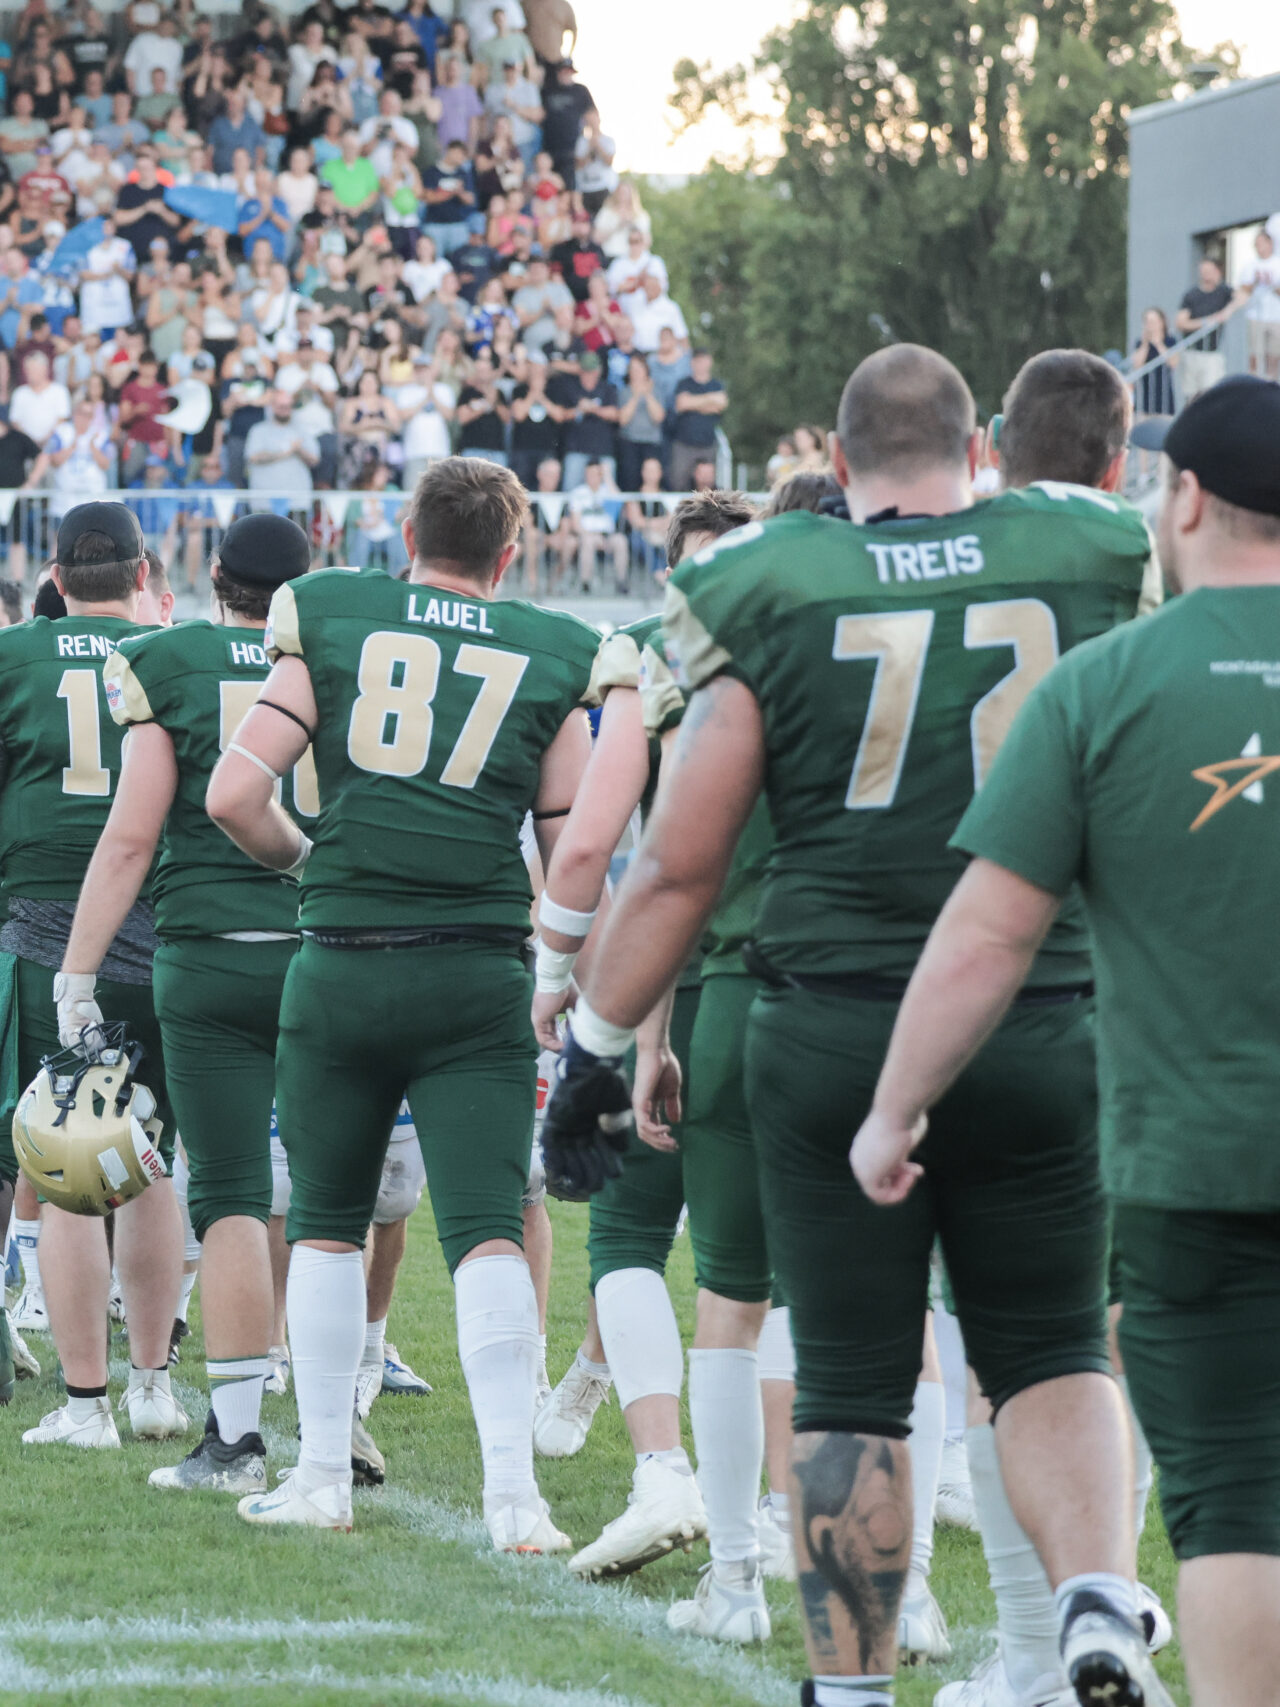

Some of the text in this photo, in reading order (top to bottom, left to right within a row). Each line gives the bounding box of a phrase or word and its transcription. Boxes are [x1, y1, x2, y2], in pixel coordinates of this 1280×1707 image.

[865, 534, 985, 584] TREIS
[407, 594, 494, 634] LAUEL
[348, 630, 531, 789] 87
[832, 598, 1061, 809] 72
